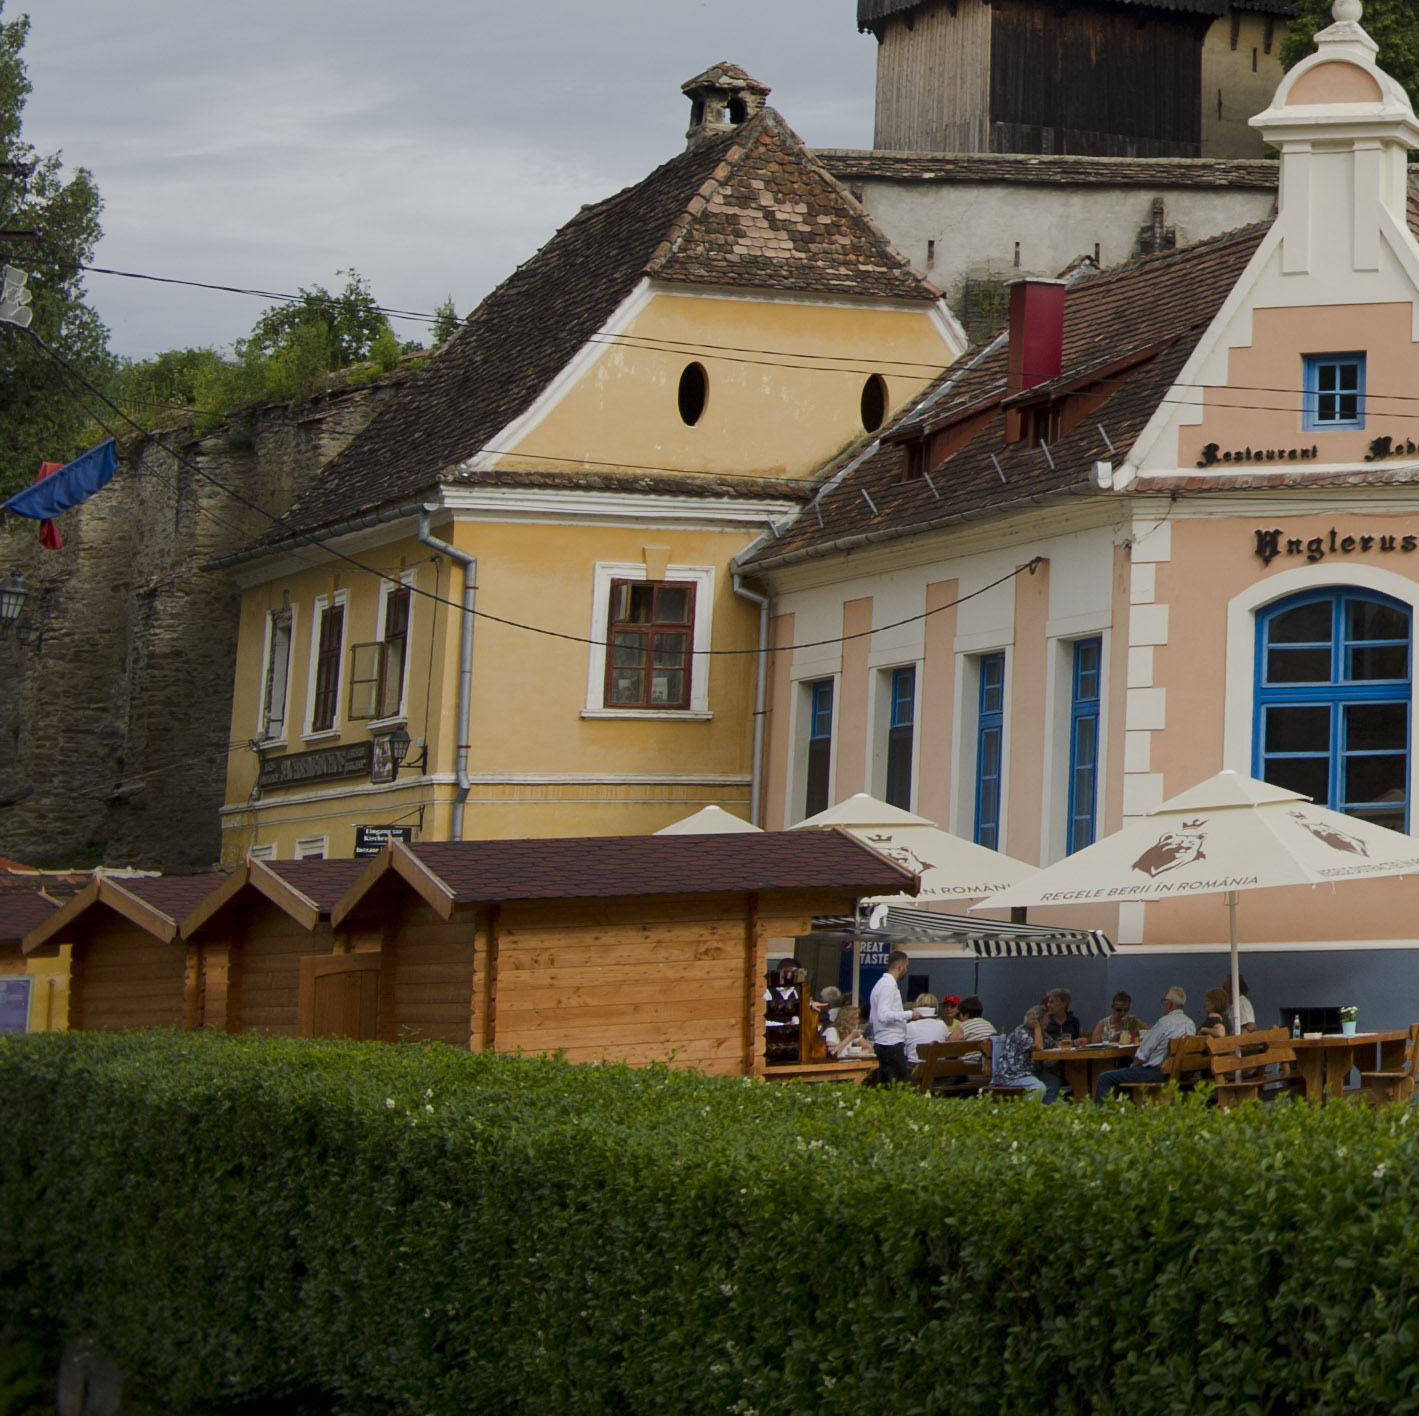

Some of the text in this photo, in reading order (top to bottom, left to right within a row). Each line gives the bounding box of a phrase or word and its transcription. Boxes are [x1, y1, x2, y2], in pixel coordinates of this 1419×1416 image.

[1197, 442, 1318, 468] Restaurant
[1039, 888, 1107, 902] REGELE
[1107, 885, 1151, 896] BERII
[1177, 876, 1259, 891] ROMÂNIA
[859, 942, 884, 953] REAT
[859, 953, 889, 965] TASTE
